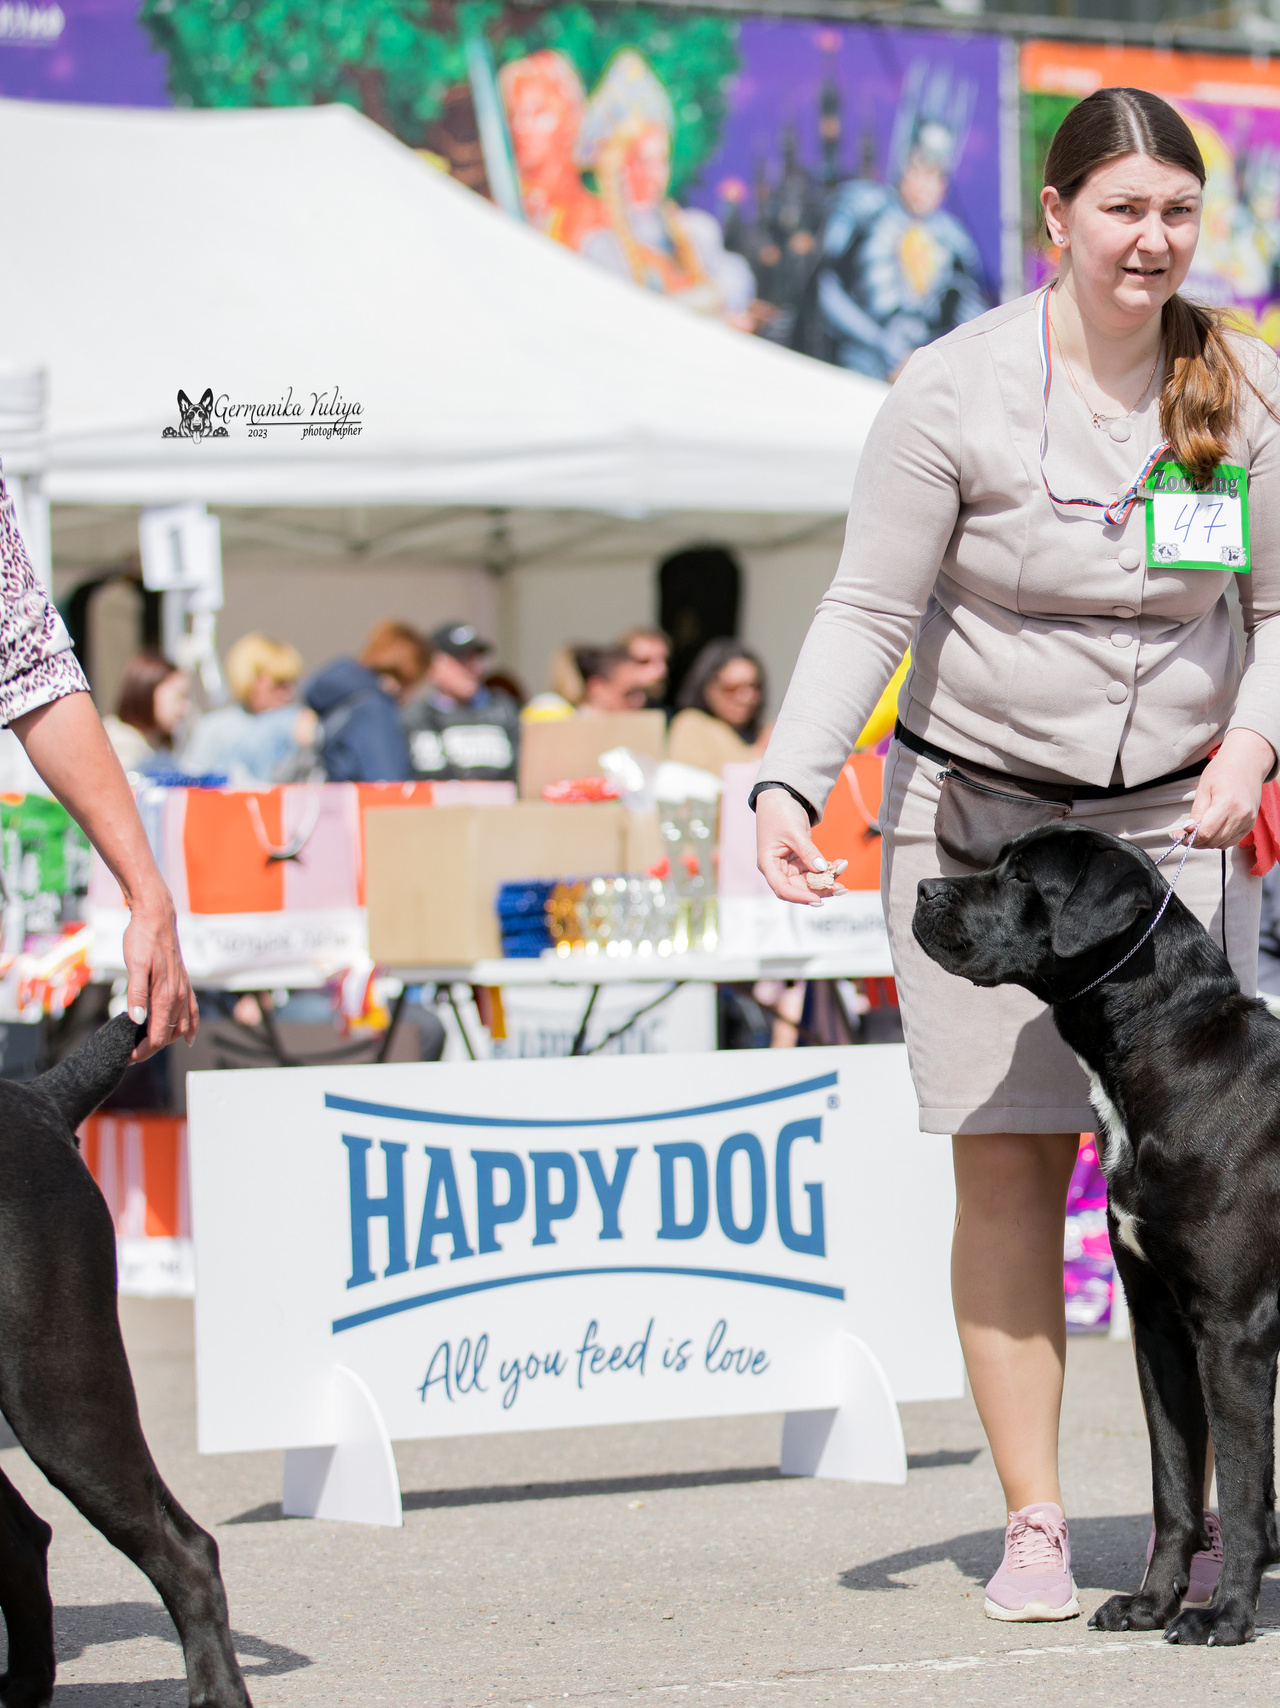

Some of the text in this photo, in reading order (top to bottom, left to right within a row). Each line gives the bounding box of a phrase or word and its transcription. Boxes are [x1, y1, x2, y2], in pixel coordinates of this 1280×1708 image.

[1153, 469, 1240, 500] Zoong
[1174, 502, 1227, 543] 47
[341, 1115, 826, 1290] HAPPY DOG
[417, 1317, 771, 1410] All you feed is love
